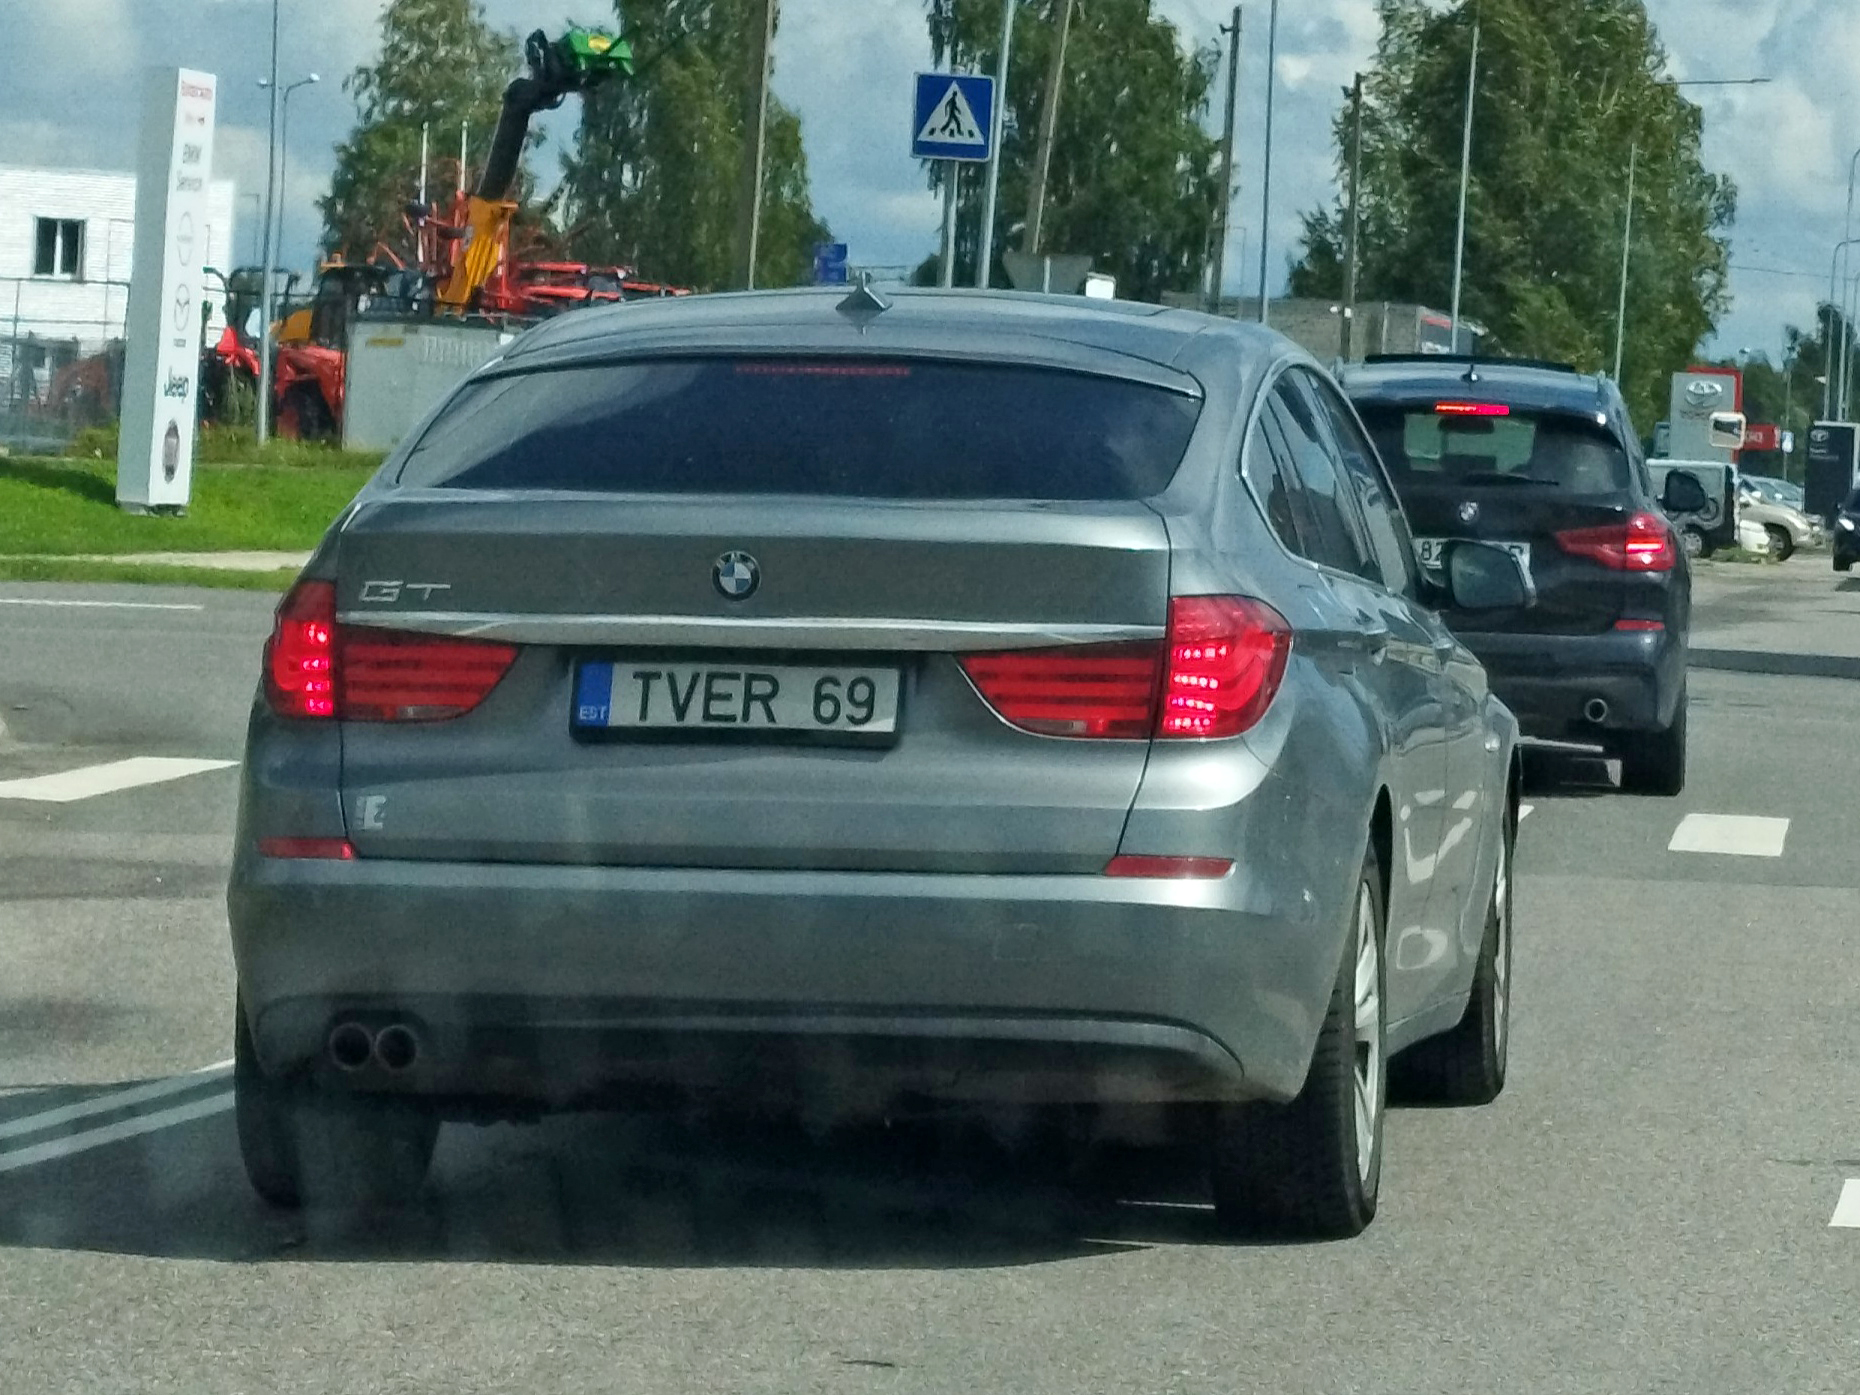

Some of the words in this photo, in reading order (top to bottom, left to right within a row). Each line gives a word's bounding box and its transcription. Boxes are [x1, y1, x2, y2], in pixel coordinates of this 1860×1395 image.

[164, 366, 190, 404] Jeep
[359, 580, 452, 602] GT
[633, 671, 780, 724] TVER
[812, 676, 877, 726] 69
